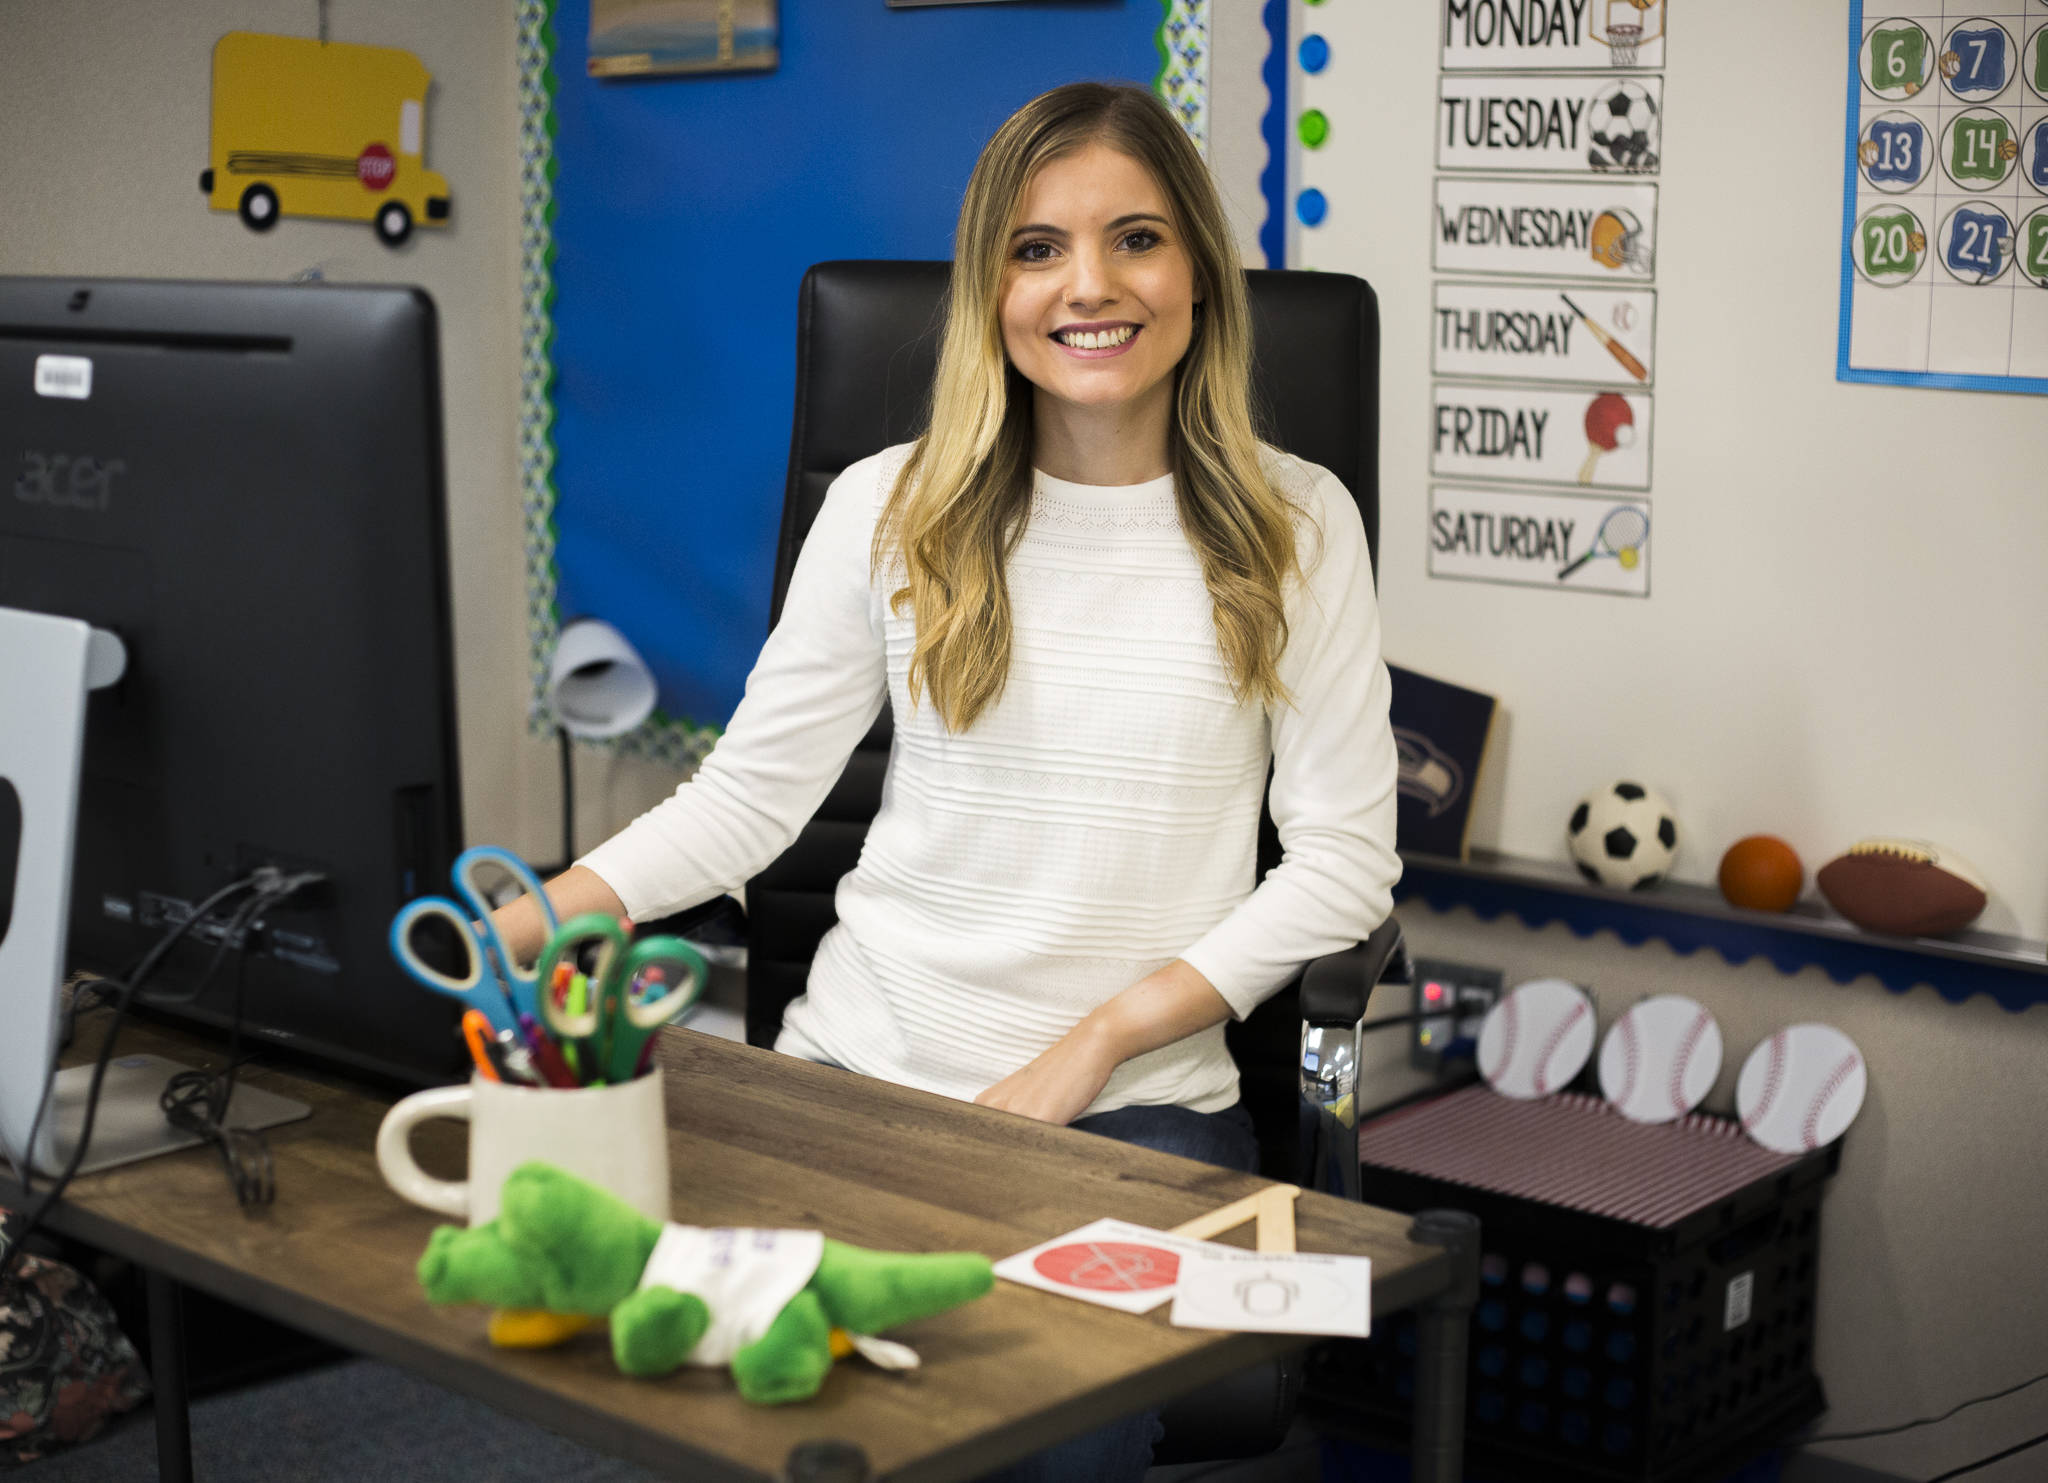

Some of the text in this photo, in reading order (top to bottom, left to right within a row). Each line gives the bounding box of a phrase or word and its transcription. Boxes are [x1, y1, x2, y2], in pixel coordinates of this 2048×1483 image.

[1444, 0, 1585, 47] MONDAY
[1886, 39, 1988, 80] 6 7
[1441, 97, 1584, 149] TUESDAY
[1878, 130, 1913, 172] 13
[1962, 128, 1998, 169] 14
[1437, 203, 1593, 250] WEDNESDAY
[1869, 223, 1908, 266] 20
[1957, 220, 1995, 264] 21
[1437, 307, 1575, 355] THURSDAY
[1435, 404, 1549, 460] FRIDAY
[1431, 509, 1575, 562] SATURDAY
